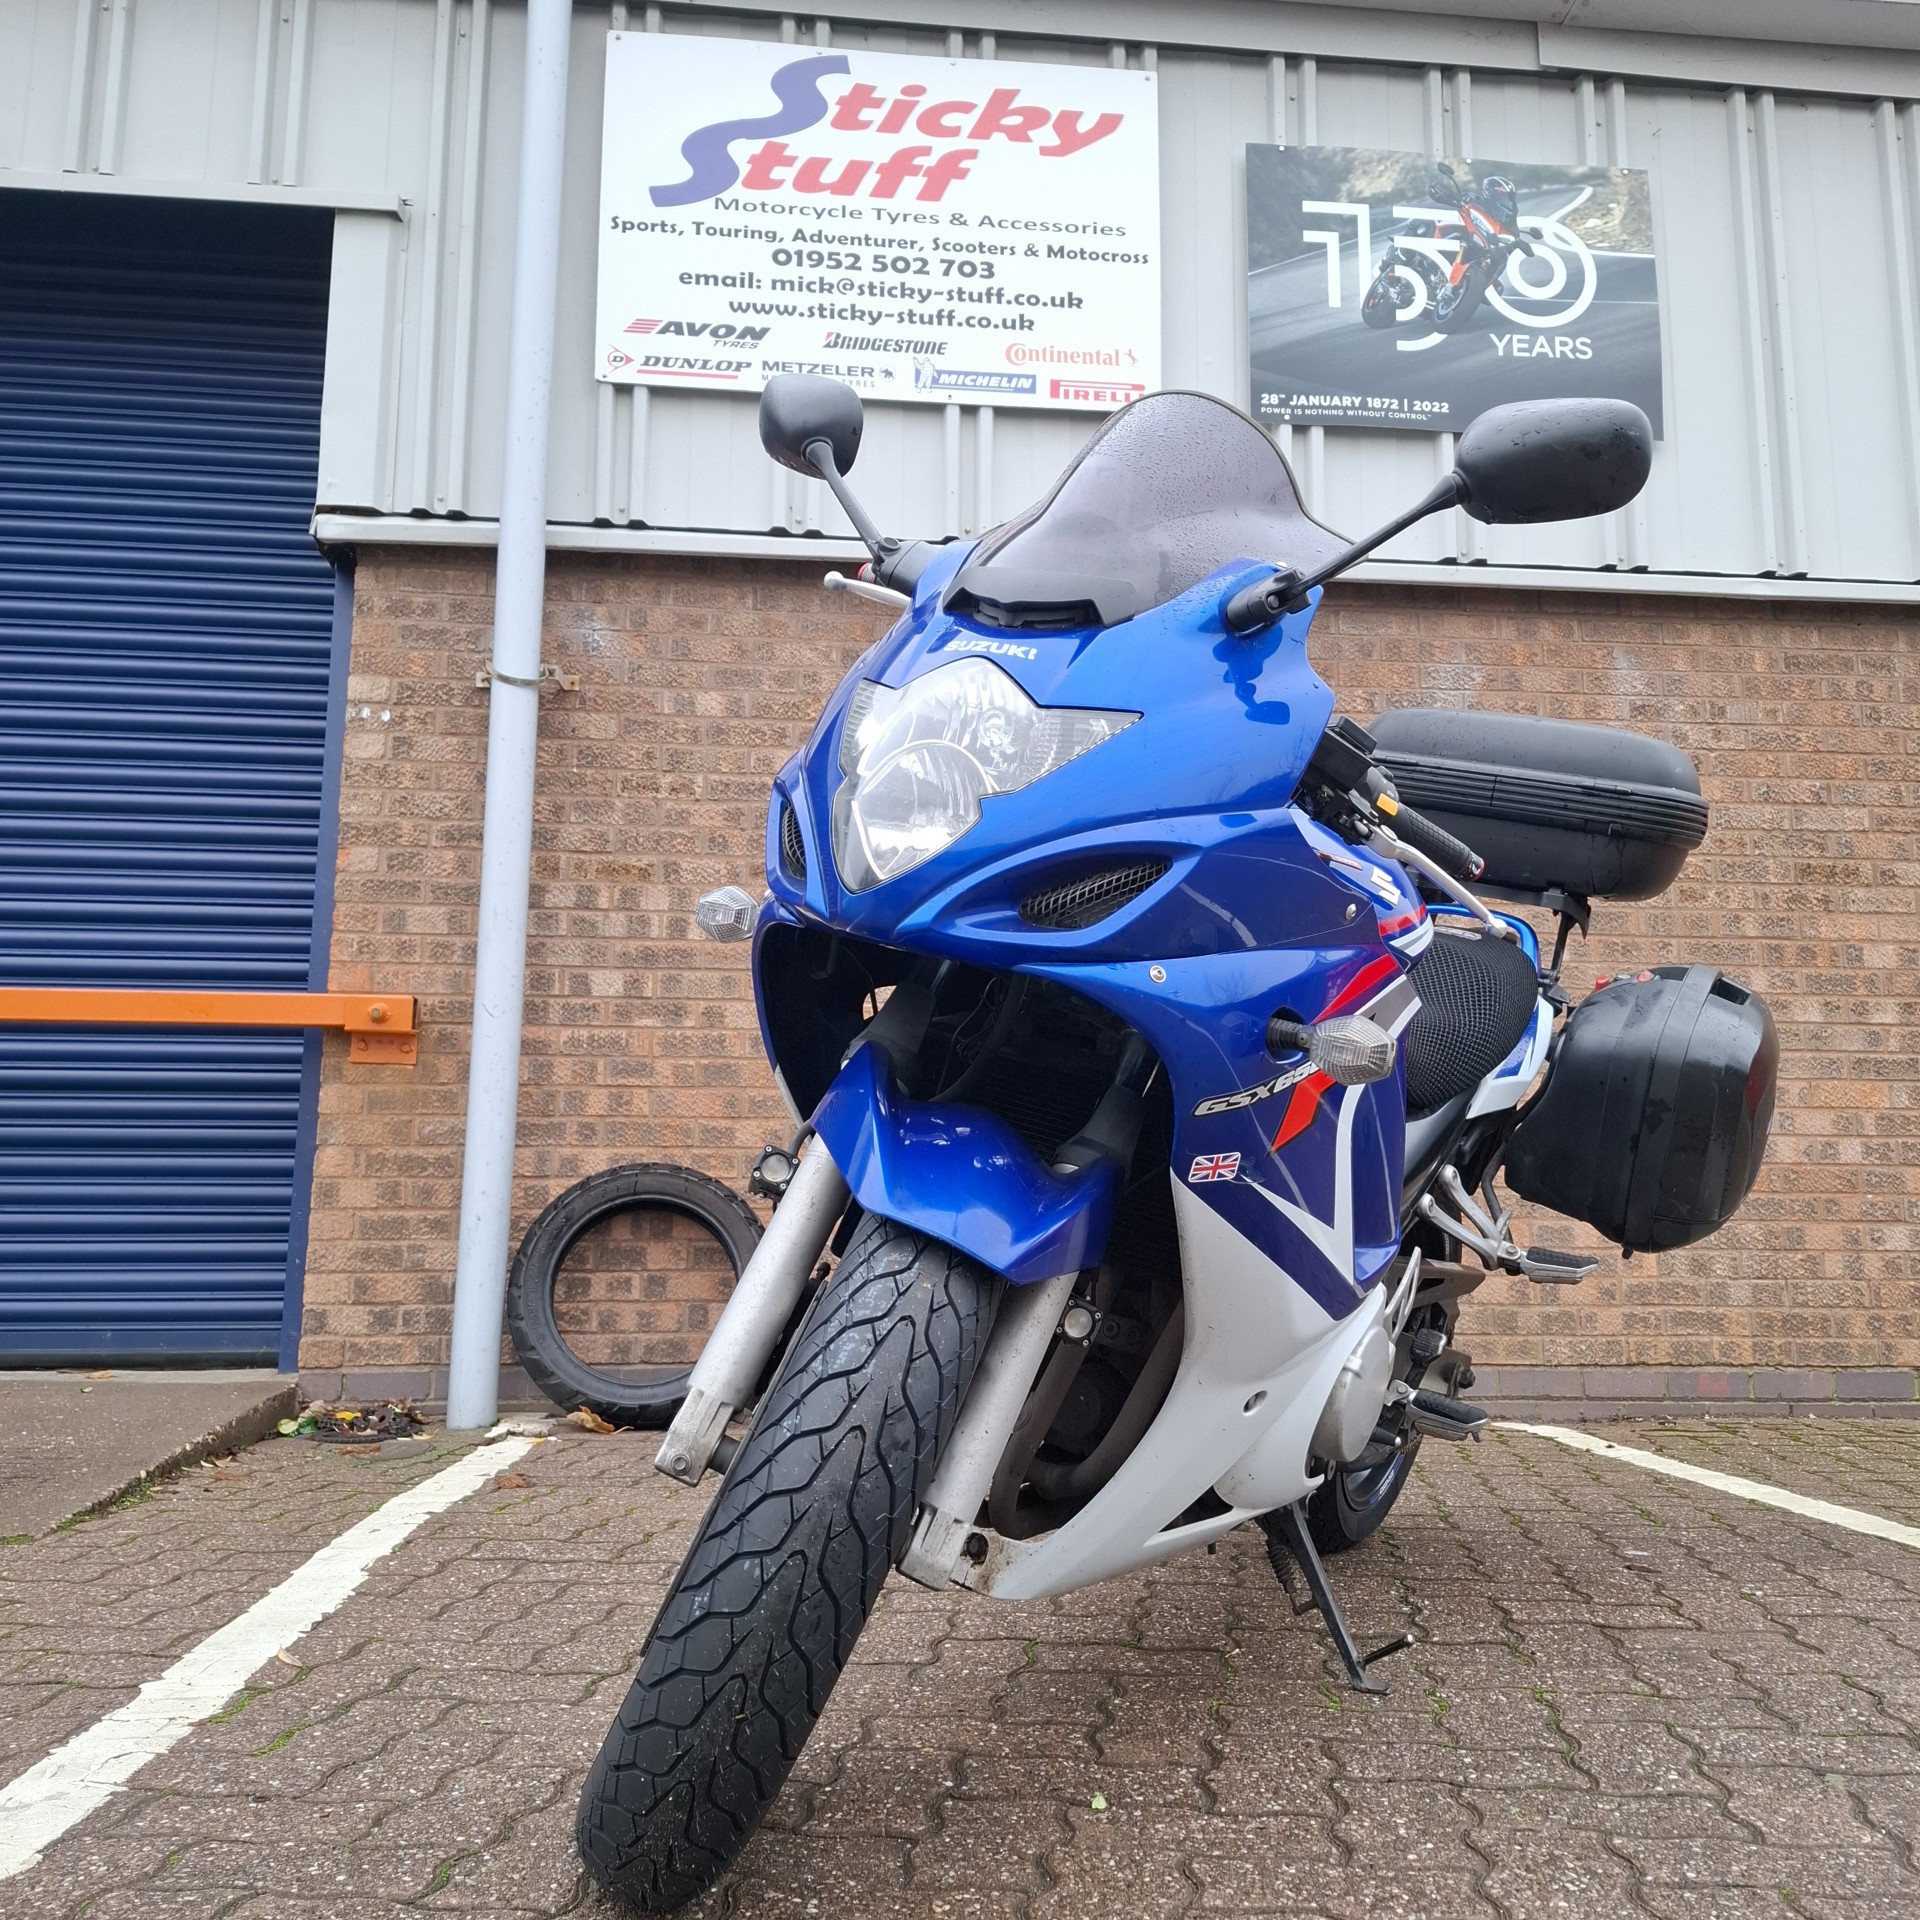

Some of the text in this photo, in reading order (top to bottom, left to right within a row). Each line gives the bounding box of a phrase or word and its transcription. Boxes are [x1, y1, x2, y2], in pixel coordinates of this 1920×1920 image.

[745, 55, 1124, 157] Sticky
[649, 119, 978, 207] Stuff
[714, 197, 1127, 237] Motorcycle Tyres & Accessories
[610, 215, 1149, 265] Sports, Touring, Adventurer, Scooters & Motocross
[771, 248, 995, 279] 01952 502 703
[678, 271, 1084, 309] email: mick@sticky-stuff.co.uk
[728, 301, 1035, 331] www.sticky-stuff.co.uk
[655, 320, 772, 341] AVON
[713, 339, 760, 349] TYRES
[822, 331, 948, 355] BRIDGESTONE
[1005, 343, 1120, 366] Continental
[1489, 333, 1593, 359] YEARS
[640, 355, 752, 373] DUNLOP
[762, 360, 875, 378] METZELER
[938, 373, 1033, 389] MICHELIN
[1289, 394, 1362, 408] JANUARY
[1366, 397, 1400, 410] 1872
[1413, 400, 1450, 413] 2022
[1305, 408, 1344, 416] NOTHING
[1346, 410, 1386, 418] WITHOUT
[944, 640, 1038, 661] SUZUKI
